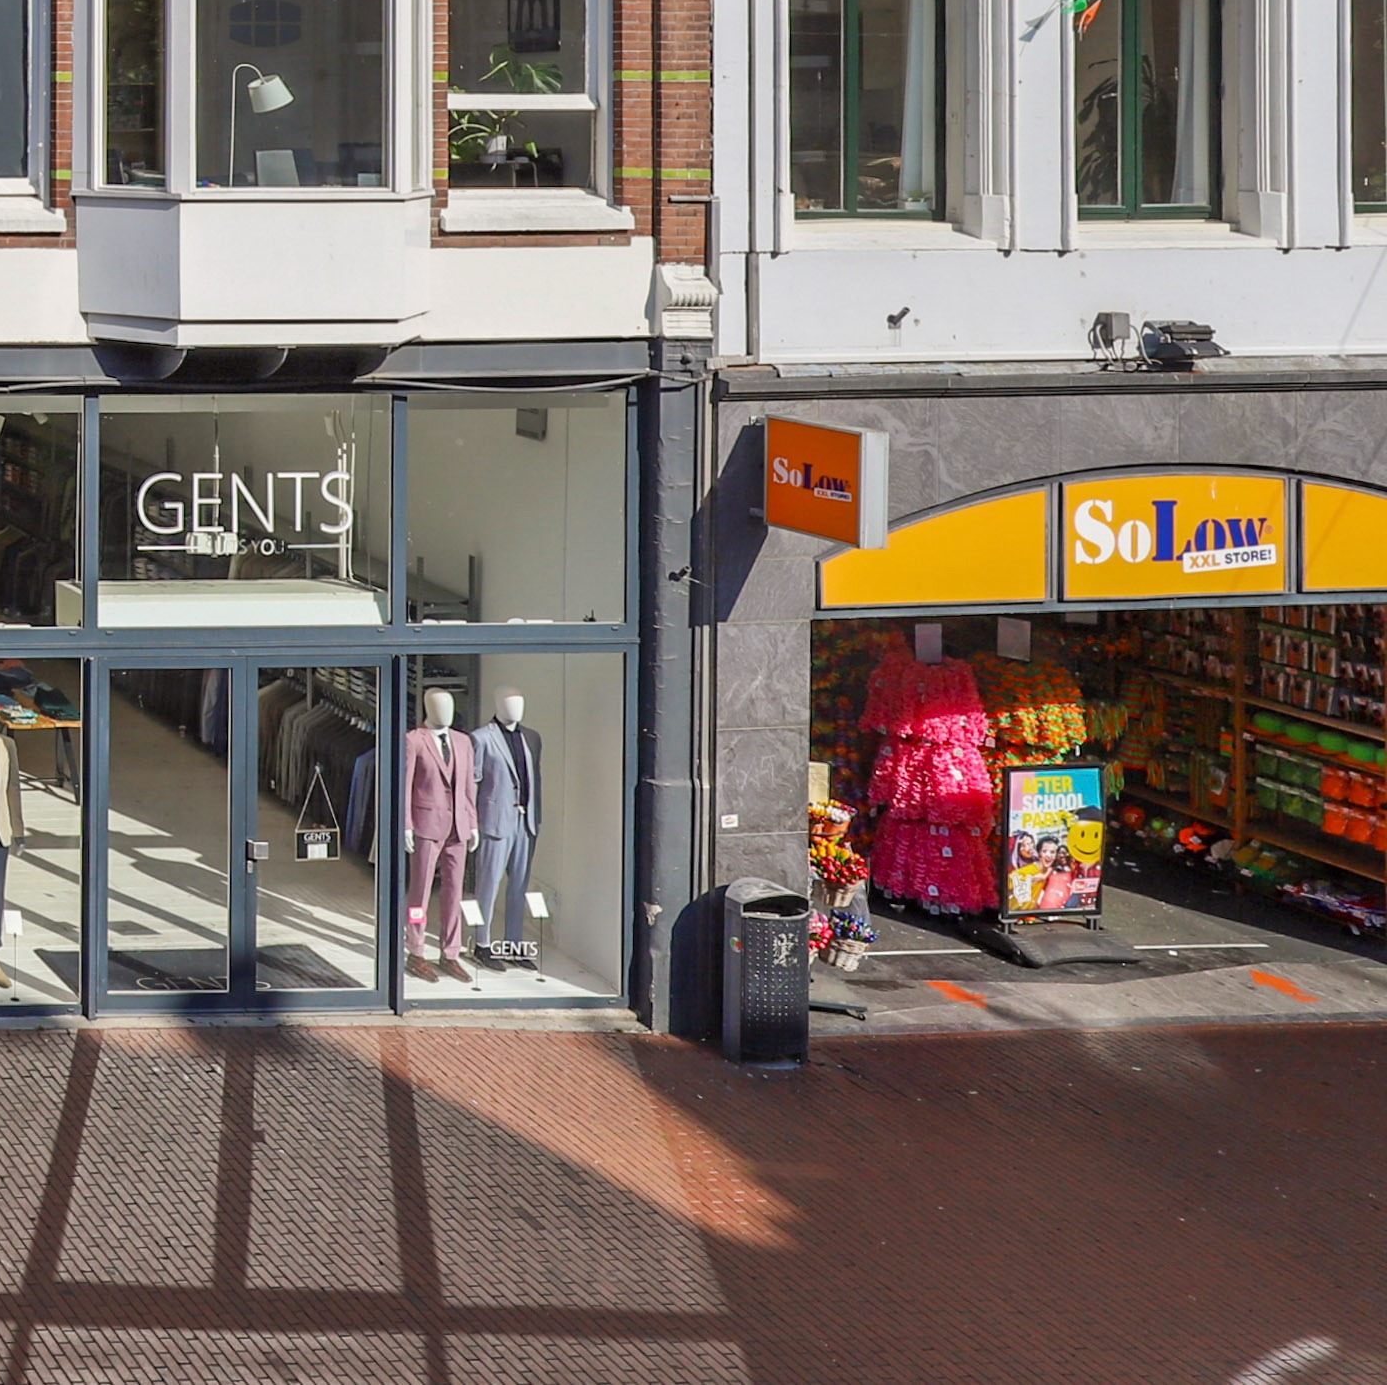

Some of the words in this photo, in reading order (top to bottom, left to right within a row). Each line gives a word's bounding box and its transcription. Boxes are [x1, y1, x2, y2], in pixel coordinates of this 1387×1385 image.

[137, 471, 353, 535] GENTS
[1074, 499, 1267, 564] SoLow
[251, 538, 284, 556] YOU
[1189, 554, 1220, 569] XXL
[1224, 549, 1272, 565] STORE!
[1023, 775, 1074, 794] AFTER
[303, 831, 332, 842] GENTS
[490, 940, 538, 956] GENTS
